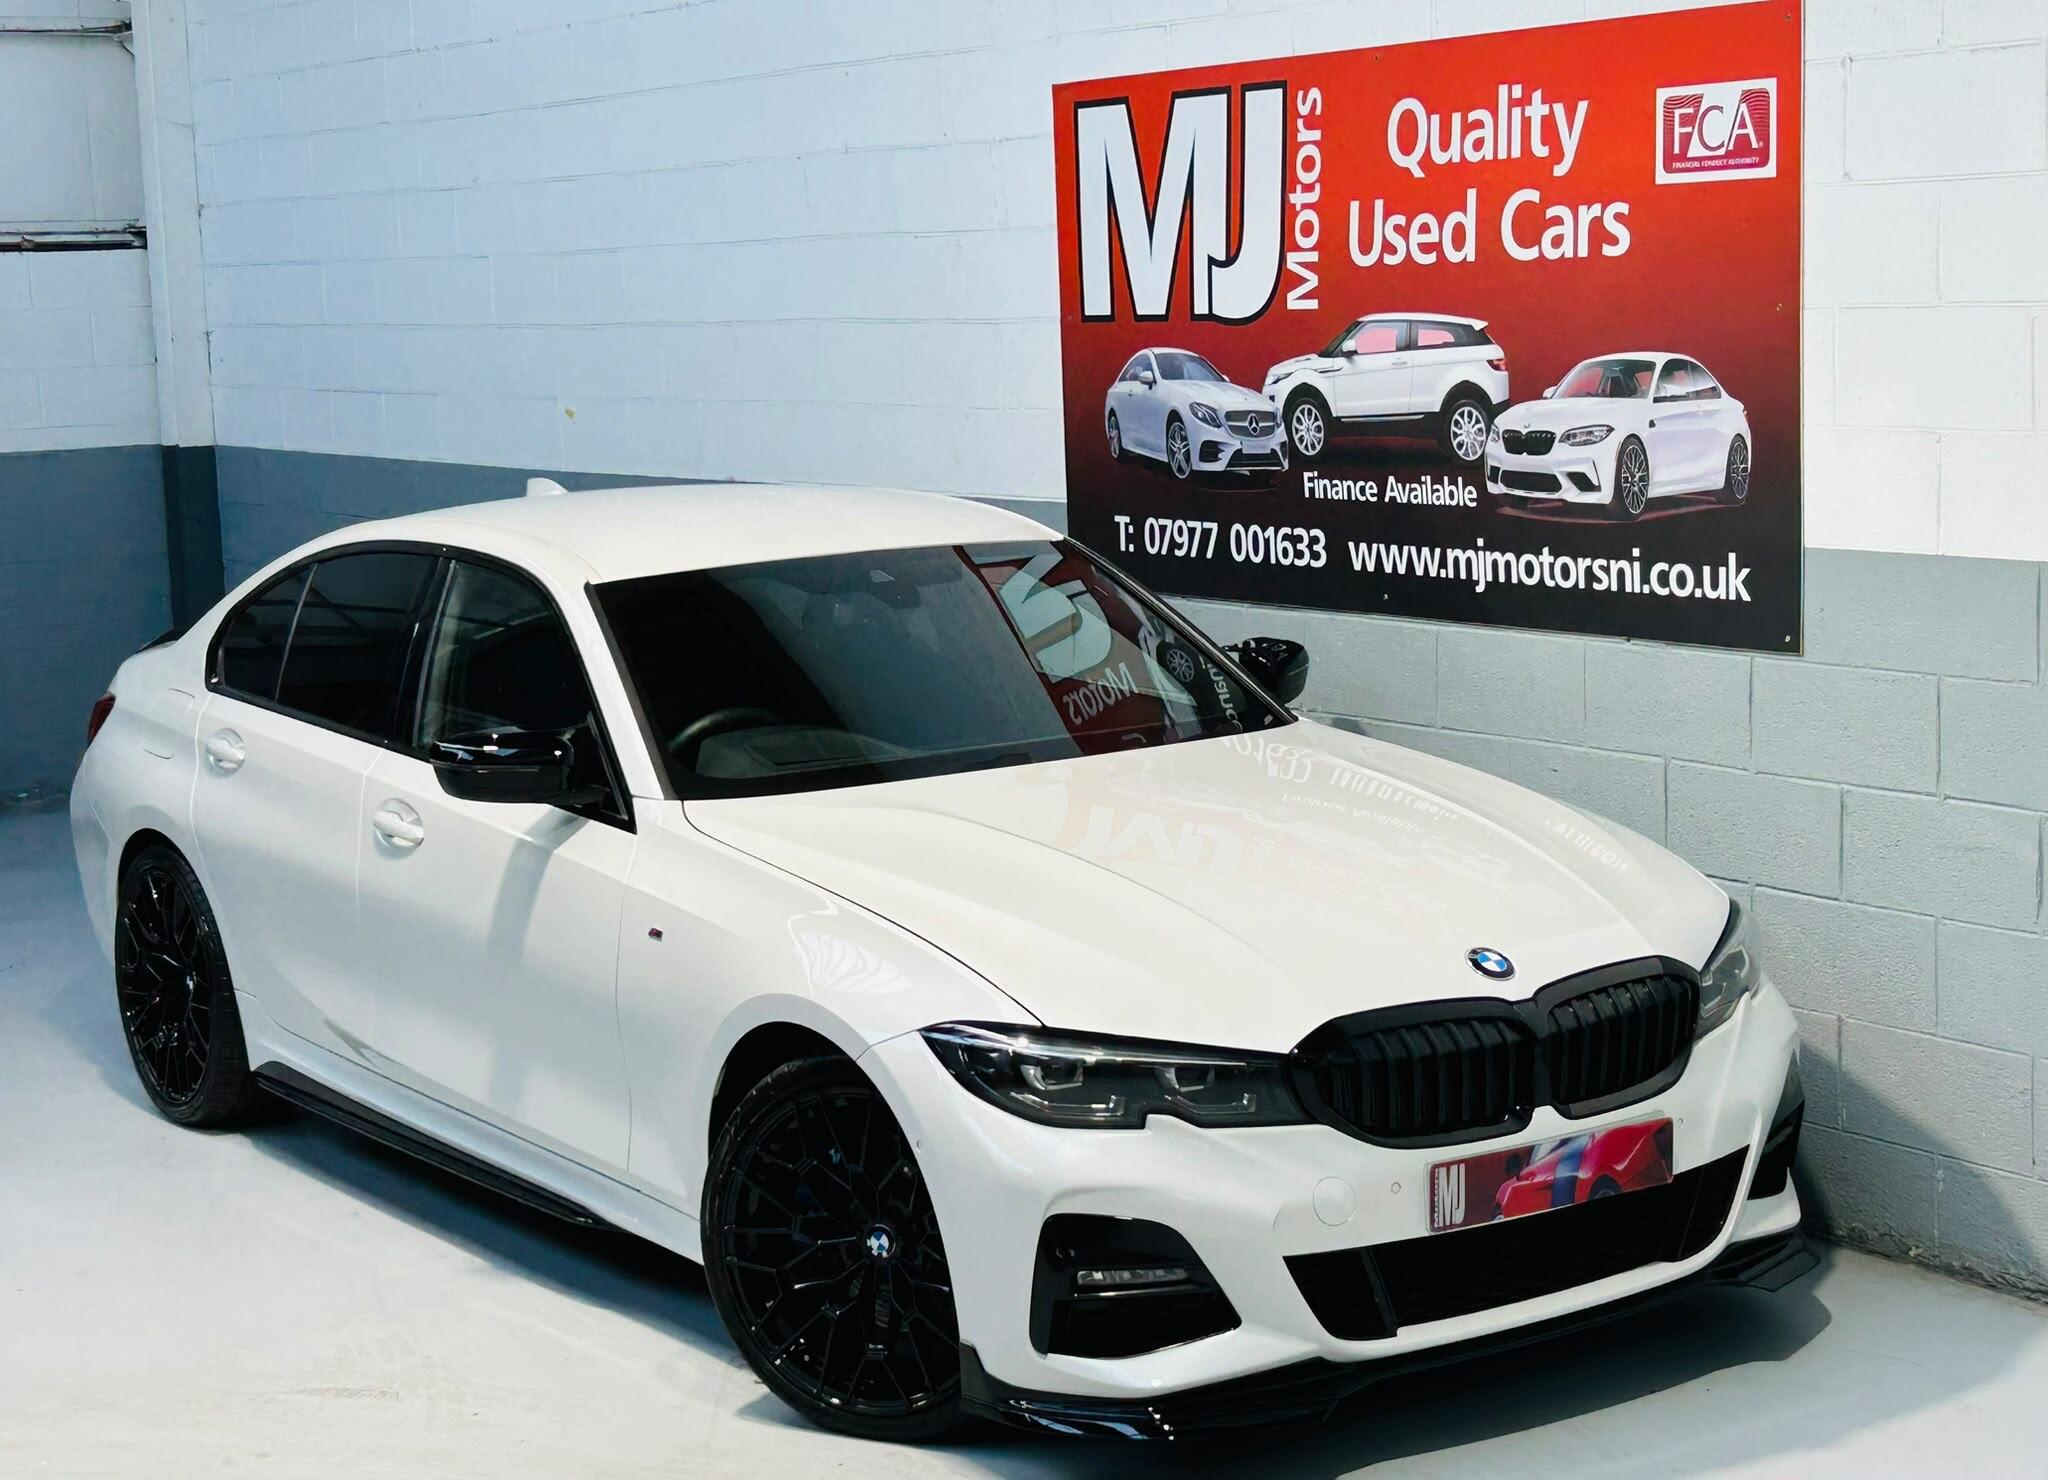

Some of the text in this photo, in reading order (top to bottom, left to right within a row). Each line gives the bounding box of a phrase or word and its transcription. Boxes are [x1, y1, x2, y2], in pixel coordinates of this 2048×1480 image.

[1387, 83, 1589, 178] Quality
[1673, 103, 1759, 155] FCA
[1074, 80, 1288, 326] MJ
[1286, 87, 1322, 310] Motors
[1348, 187, 1631, 268] Used Cars
[1303, 470, 1478, 508] Finance Available
[1114, 515, 1327, 568] T: 07977 001633
[1347, 537, 1752, 602] www.mjmotorsni.co.uk
[1438, 1163, 1466, 1227] MJ
